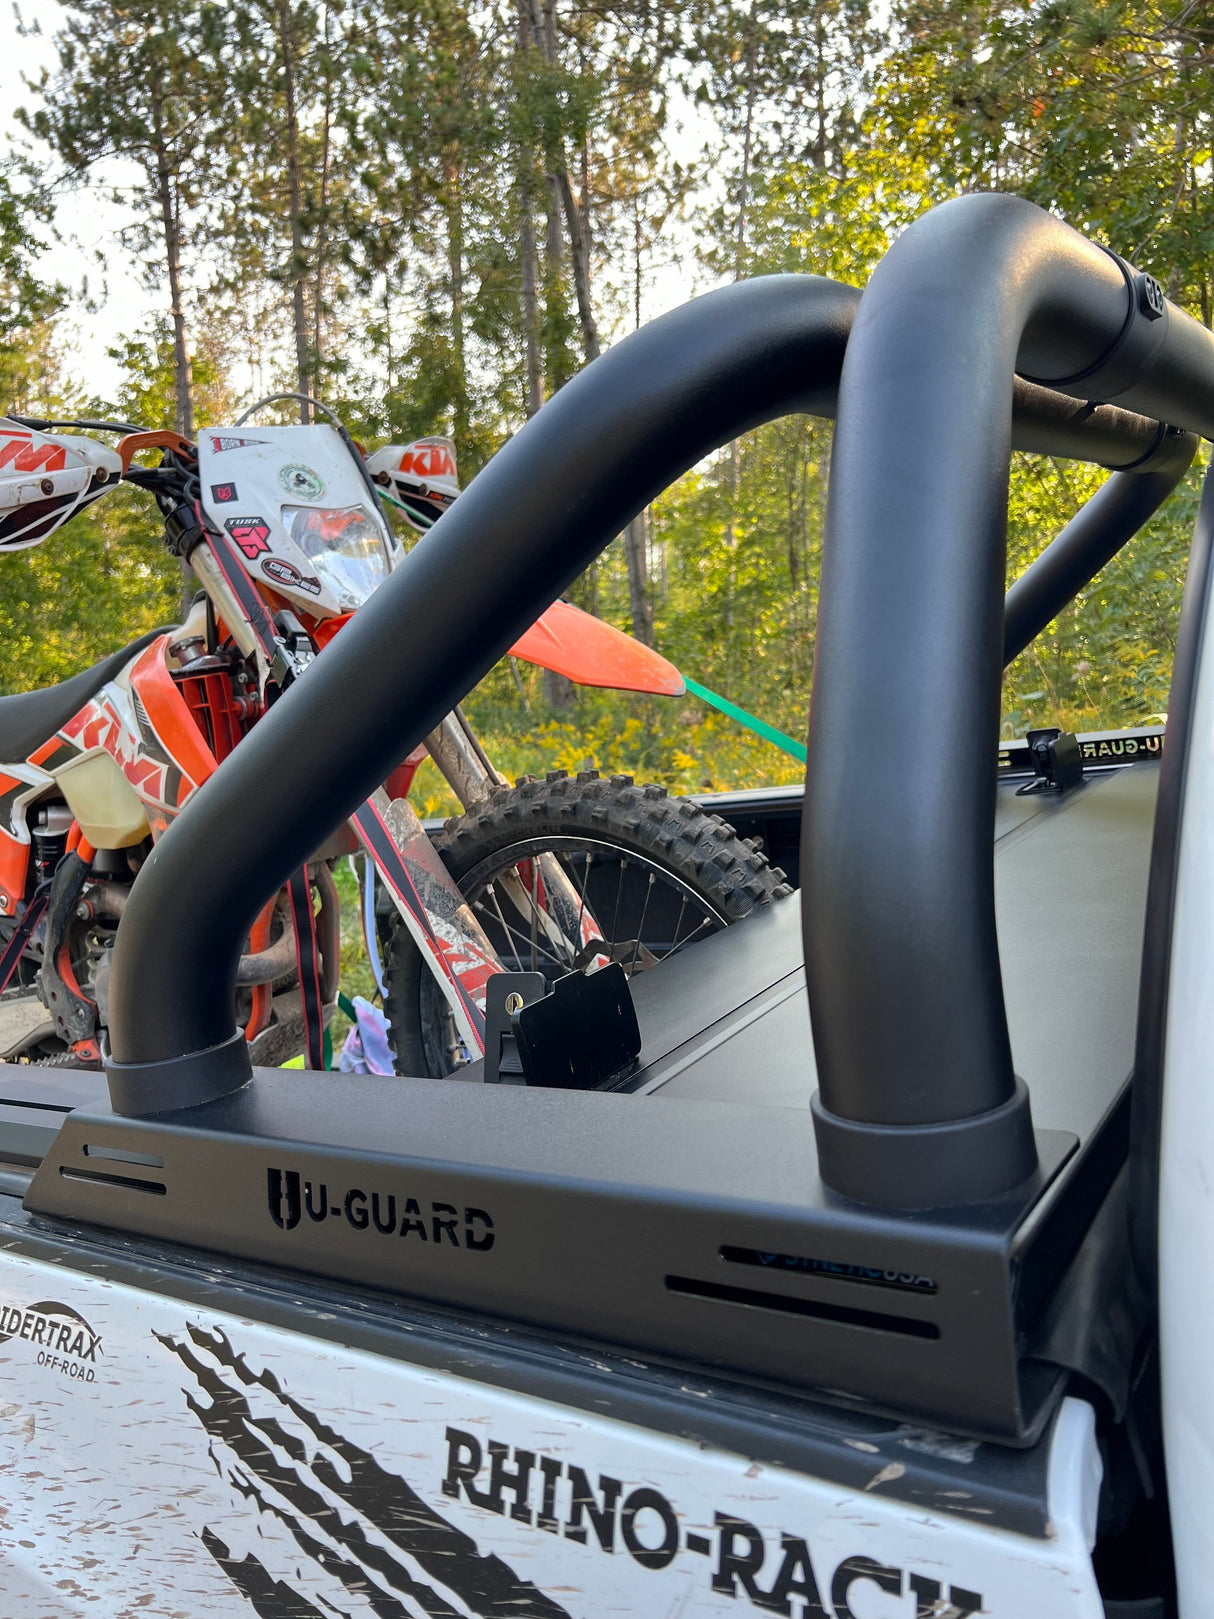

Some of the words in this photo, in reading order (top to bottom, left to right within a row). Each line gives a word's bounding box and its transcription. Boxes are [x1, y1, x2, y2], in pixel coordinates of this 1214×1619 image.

[0, 430, 66, 472] TM
[399, 444, 456, 476] KTM
[305, 1181, 495, 1251] U-GUARD
[0, 1305, 103, 1362] IDERTRAX
[37, 1351, 95, 1382] OFF-ROAD
